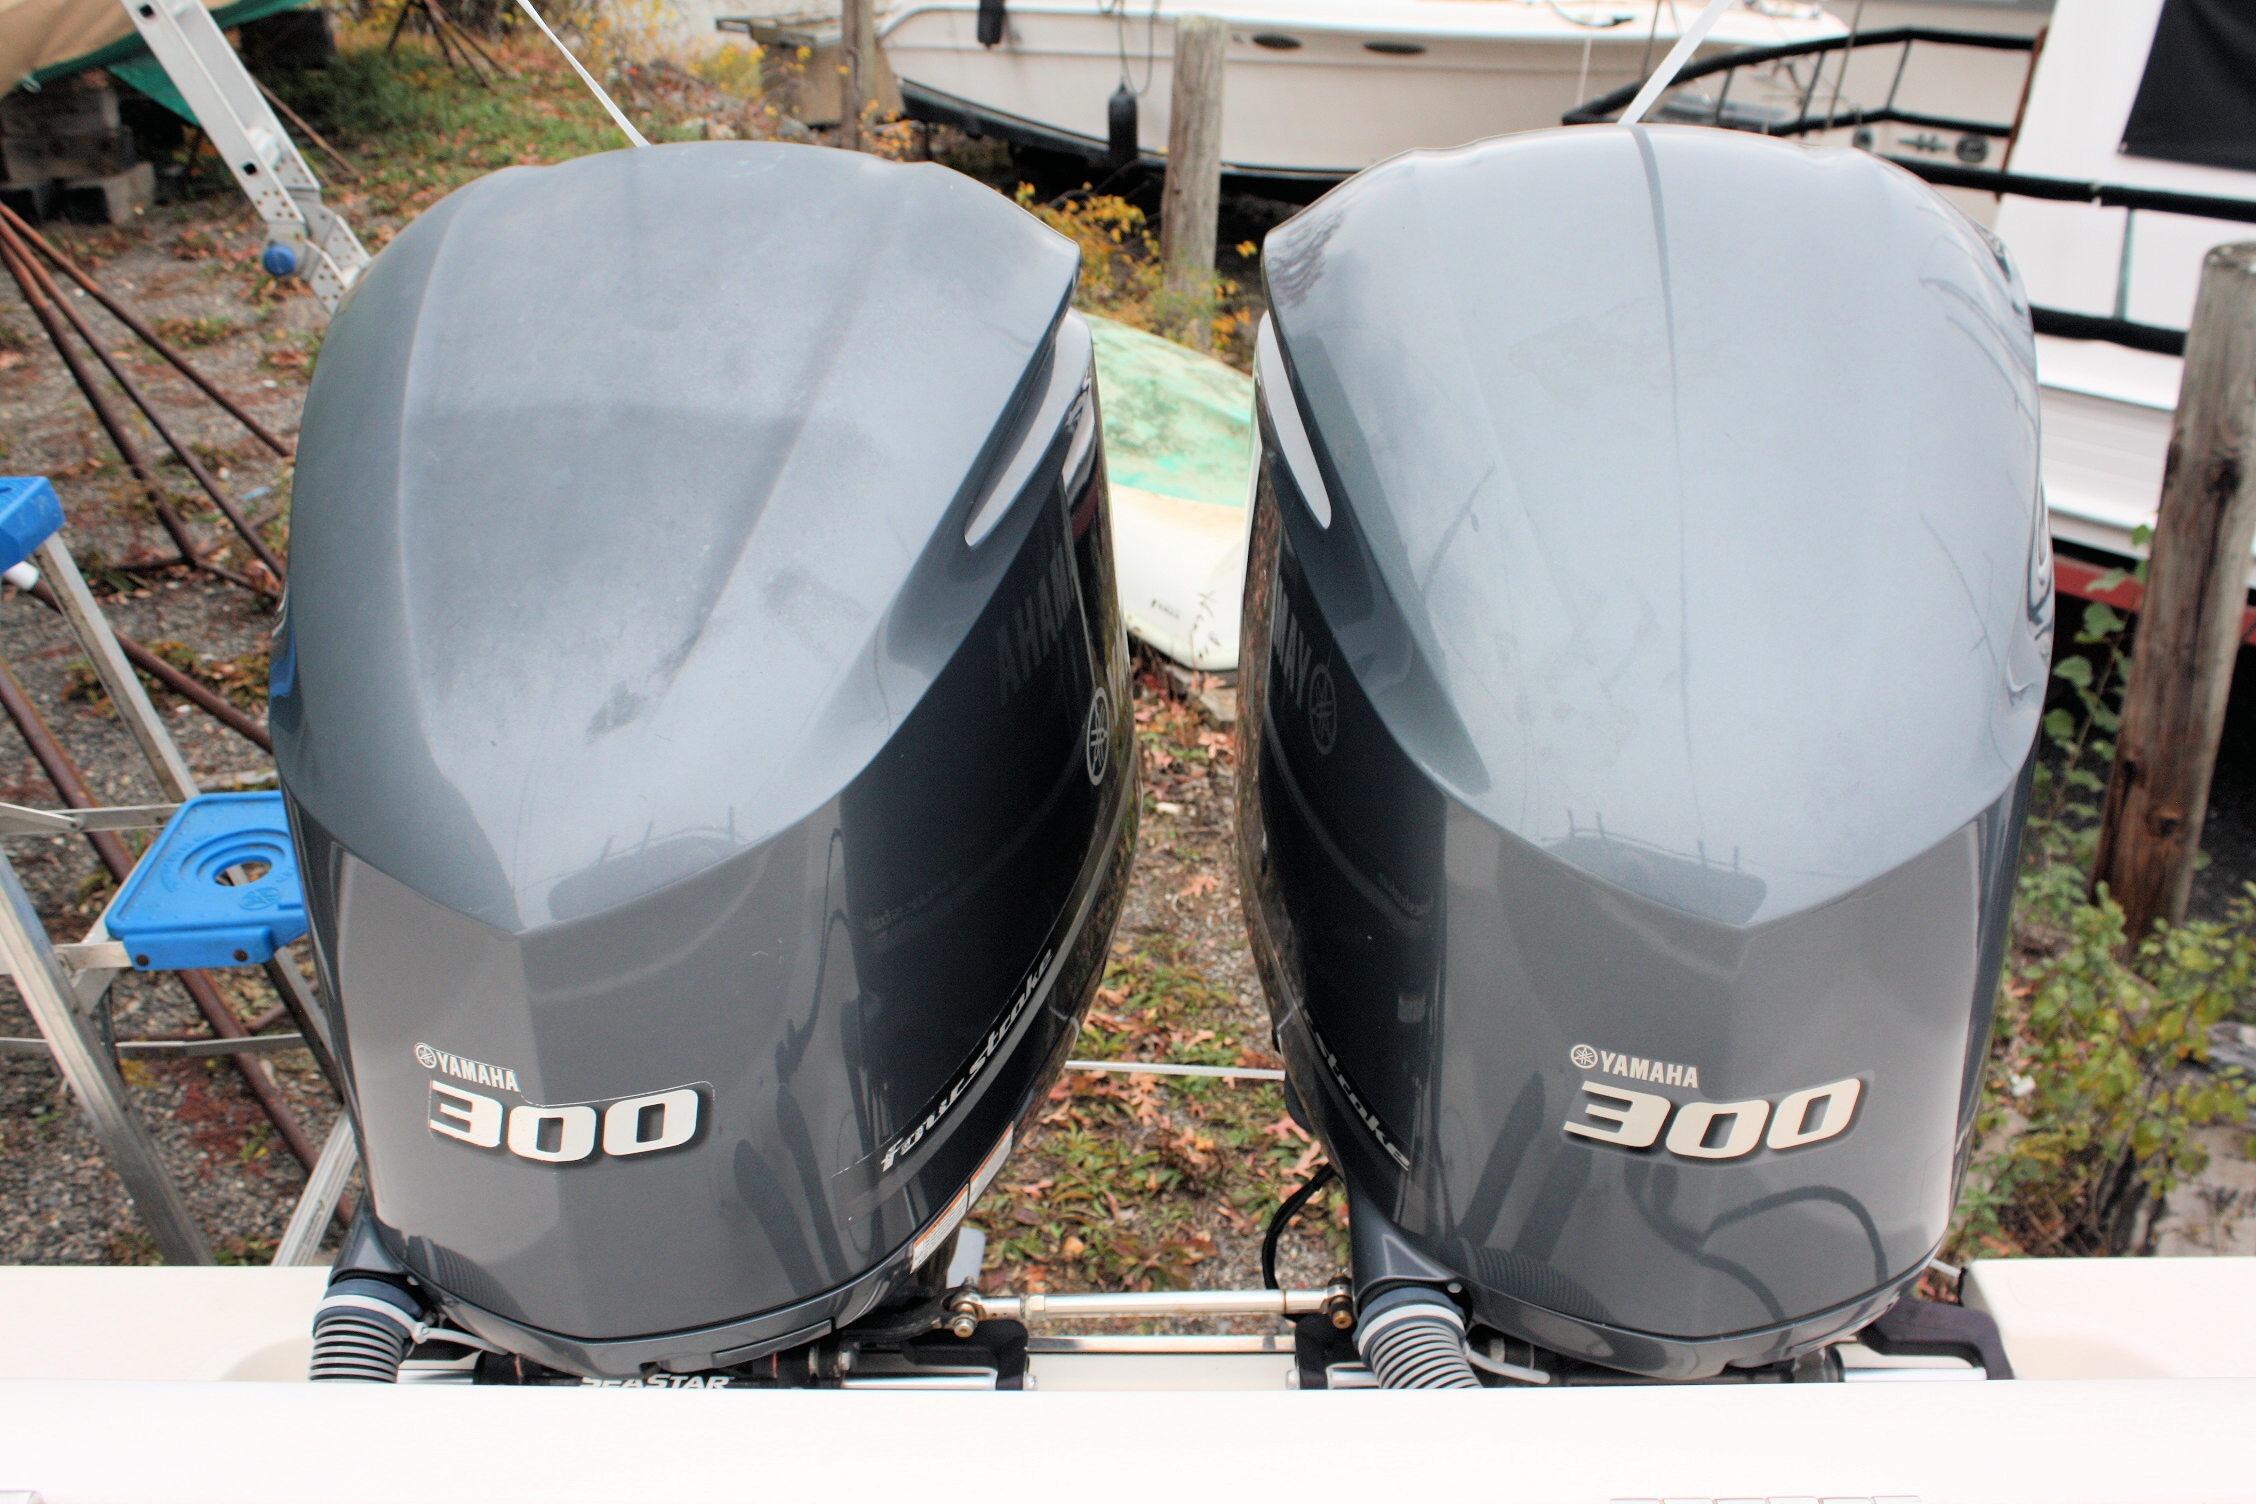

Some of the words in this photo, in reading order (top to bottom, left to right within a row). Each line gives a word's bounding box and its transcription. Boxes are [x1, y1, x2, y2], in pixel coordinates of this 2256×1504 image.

[437, 1050, 521, 1093] YAMAHA
[1600, 1050, 1699, 1089] YAMAHA
[429, 1080, 699, 1162] 300
[1563, 1078, 1861, 1159] 300
